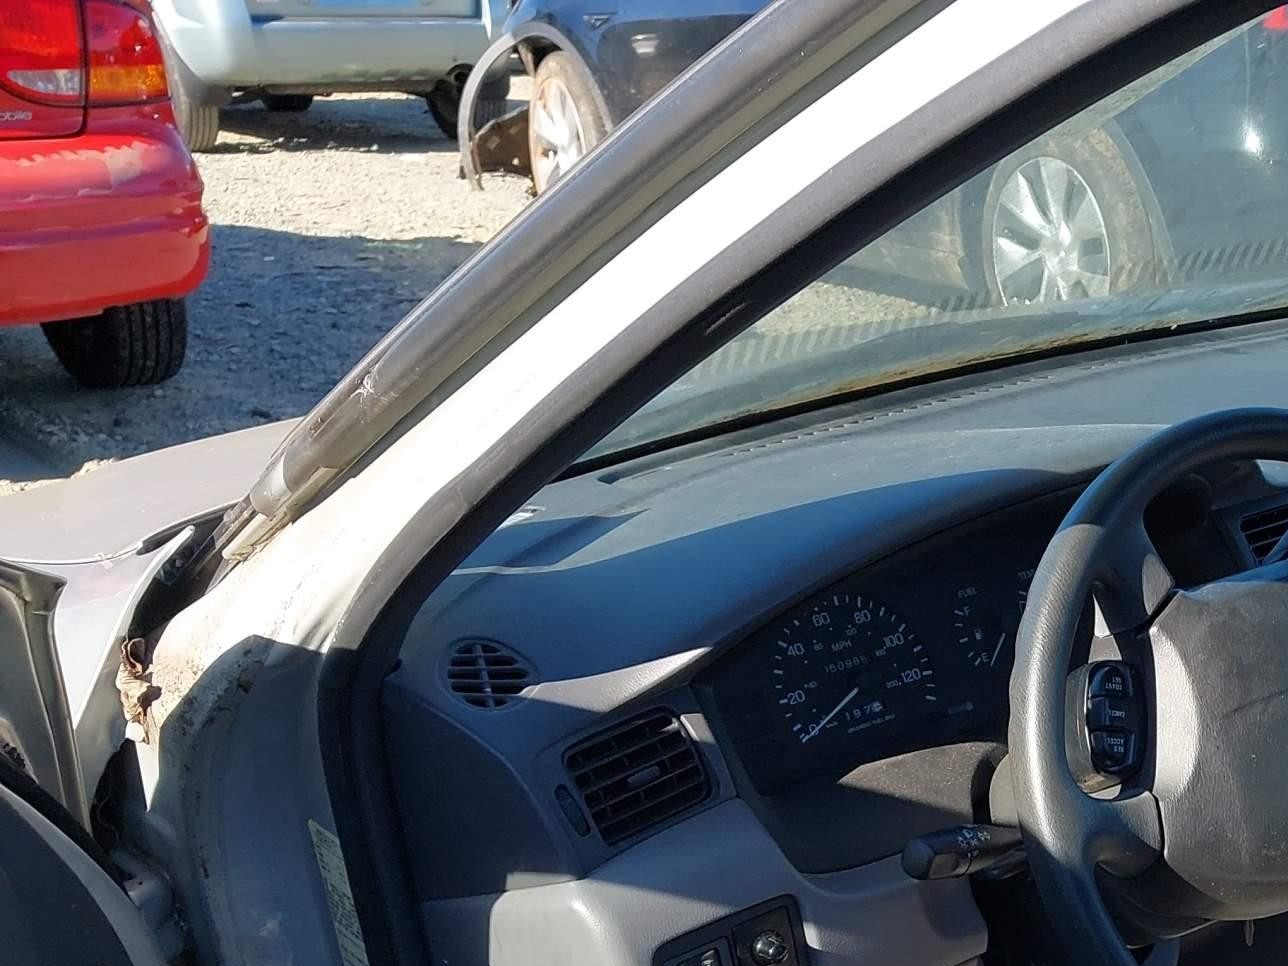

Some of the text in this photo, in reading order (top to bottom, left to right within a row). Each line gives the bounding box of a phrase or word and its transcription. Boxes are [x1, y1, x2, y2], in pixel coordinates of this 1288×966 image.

[812, 612, 831, 627] 60
[854, 609, 871, 624] 80
[831, 639, 852, 652] MPH
[883, 632, 905, 648] 100
[787, 642, 805, 657] 40
[900, 667, 922, 684] 120
[787, 690, 806, 705] 20
